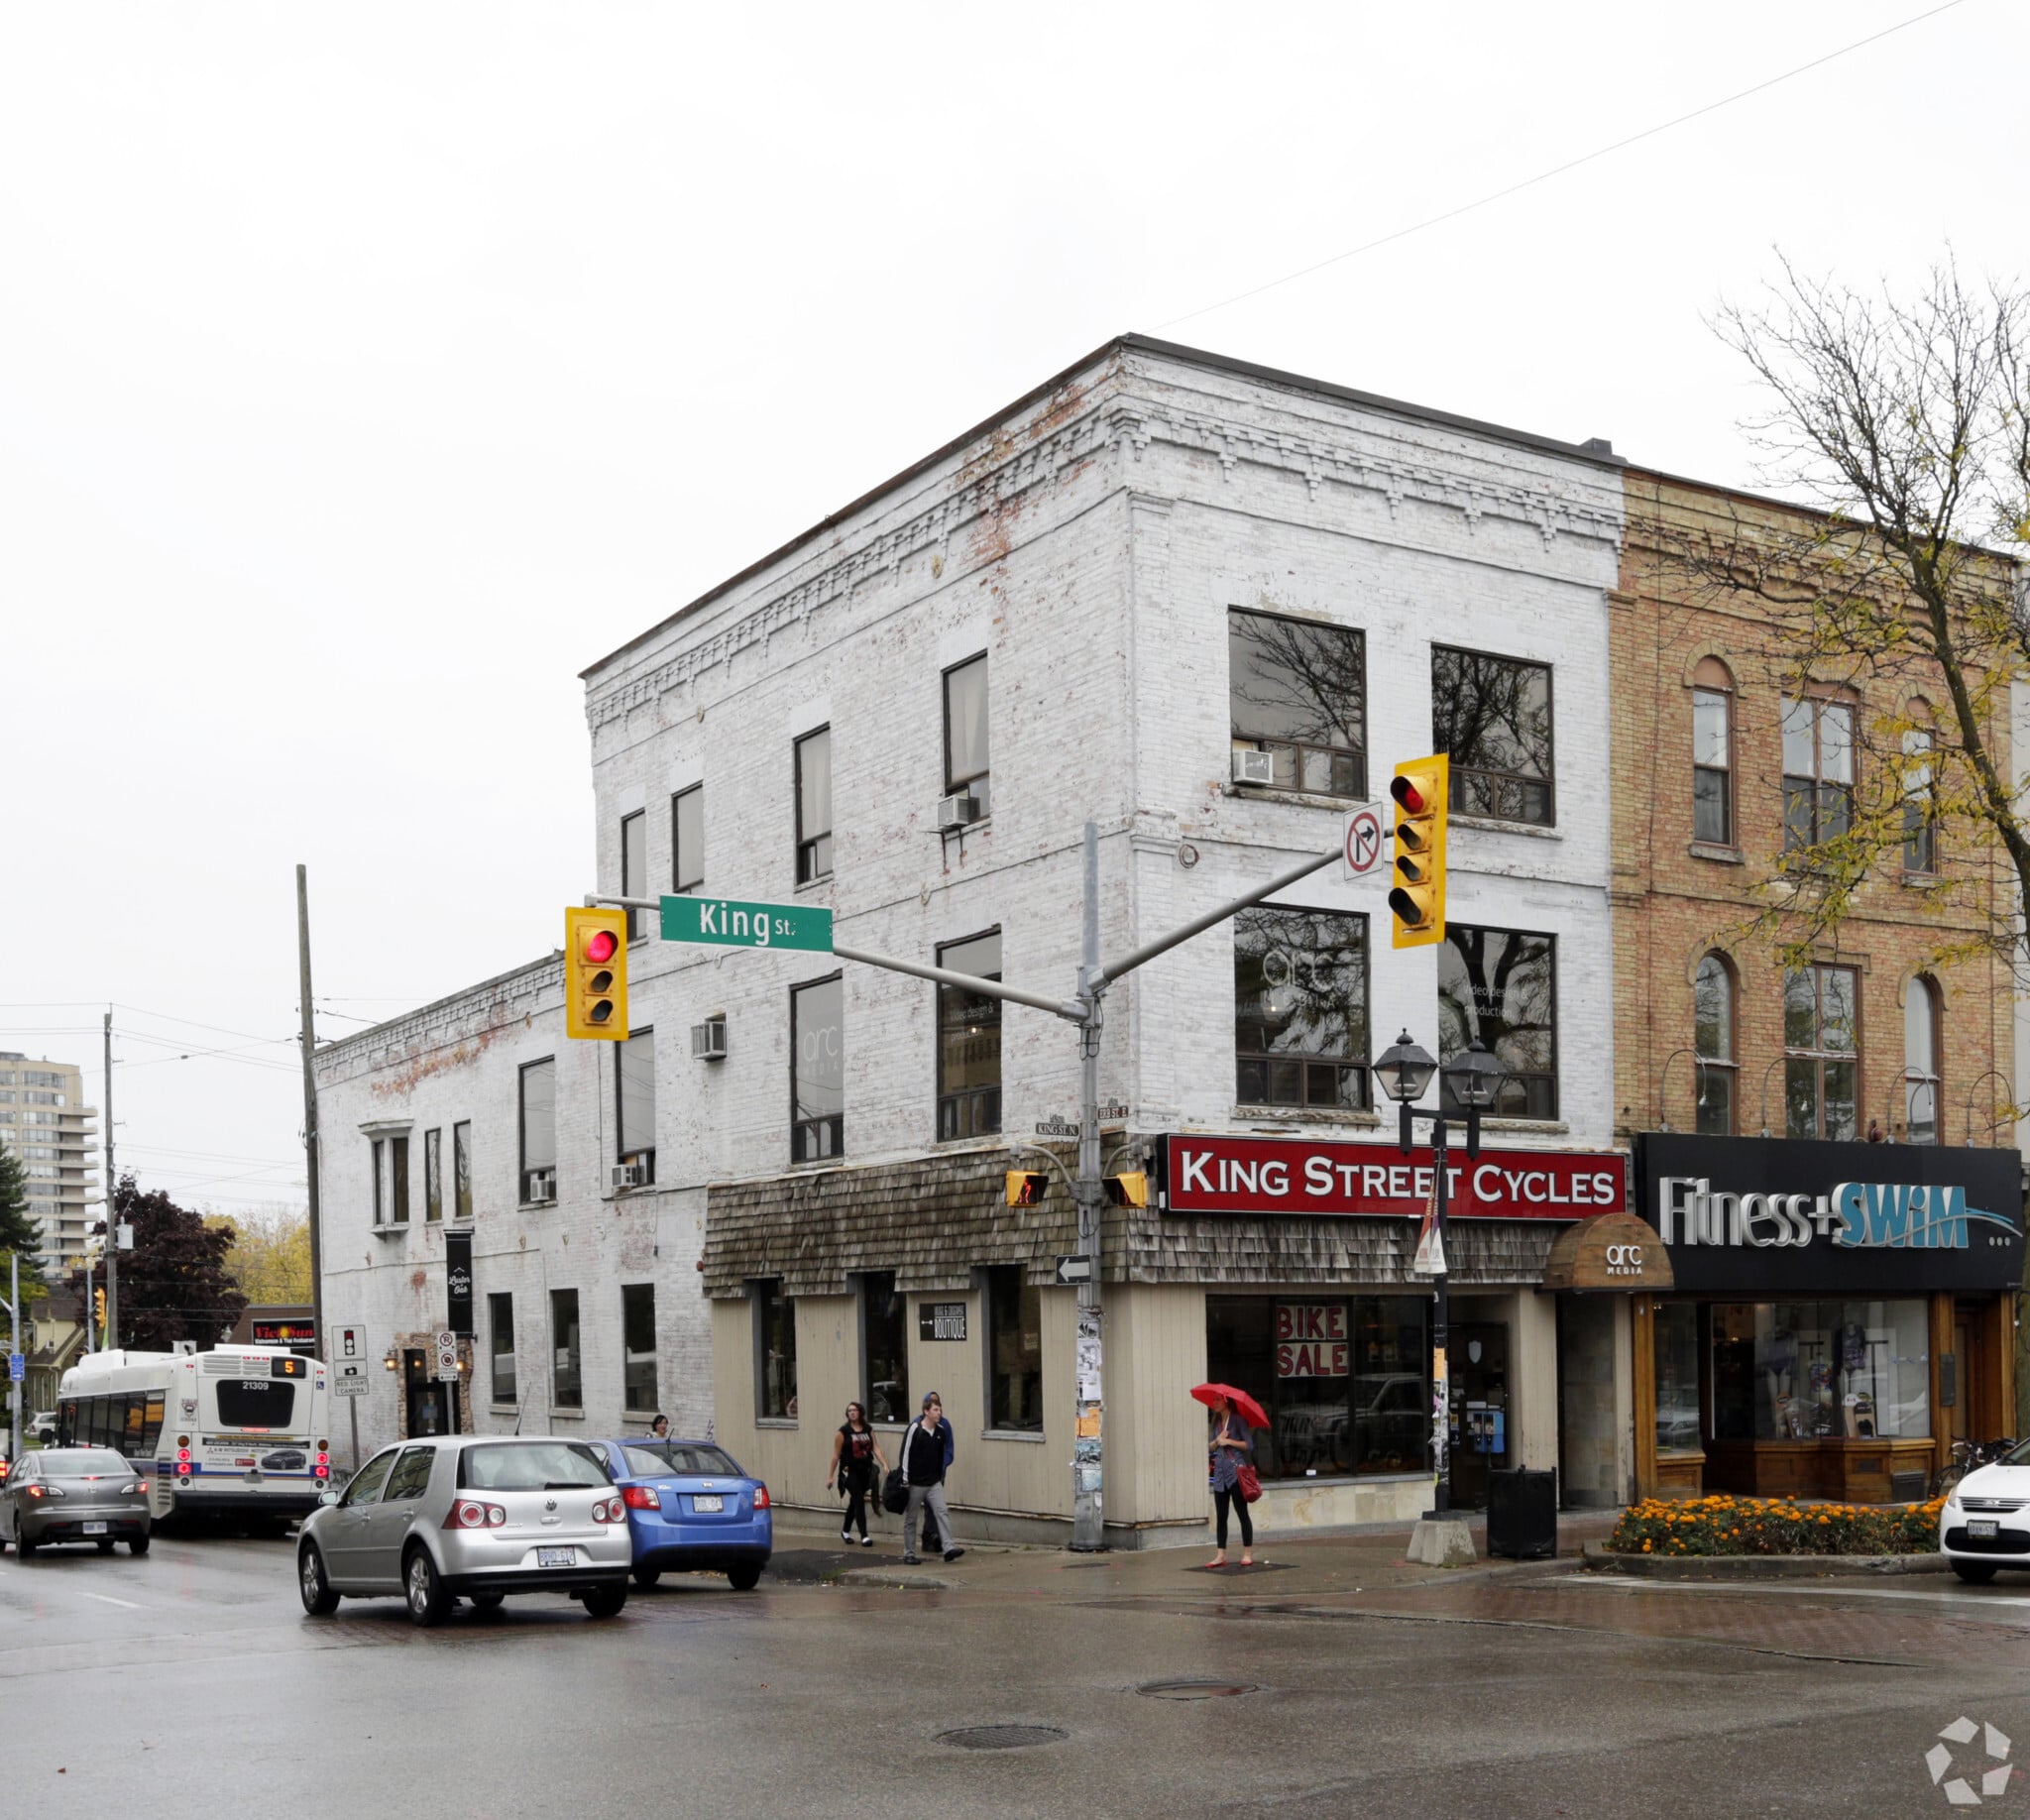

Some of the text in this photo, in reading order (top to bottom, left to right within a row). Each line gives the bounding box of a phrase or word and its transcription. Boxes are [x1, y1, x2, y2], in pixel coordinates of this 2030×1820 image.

[700, 902, 796, 946] King St.
[1263, 950, 1334, 992] arc
[804, 1026, 838, 1061] arc
[1038, 1123, 1058, 1135] KING
[1181, 1151, 1290, 1196] KING
[1473, 1164, 1615, 1205] CYCLES
[1607, 1245, 1642, 1265] arc
[935, 1318, 965, 1339] BOUTIQUE
[1276, 1307, 1344, 1339] BIKE
[284, 1361, 293, 1374] 5
[1276, 1344, 1348, 1376] SALE
[243, 1381, 269, 1390] 21309
